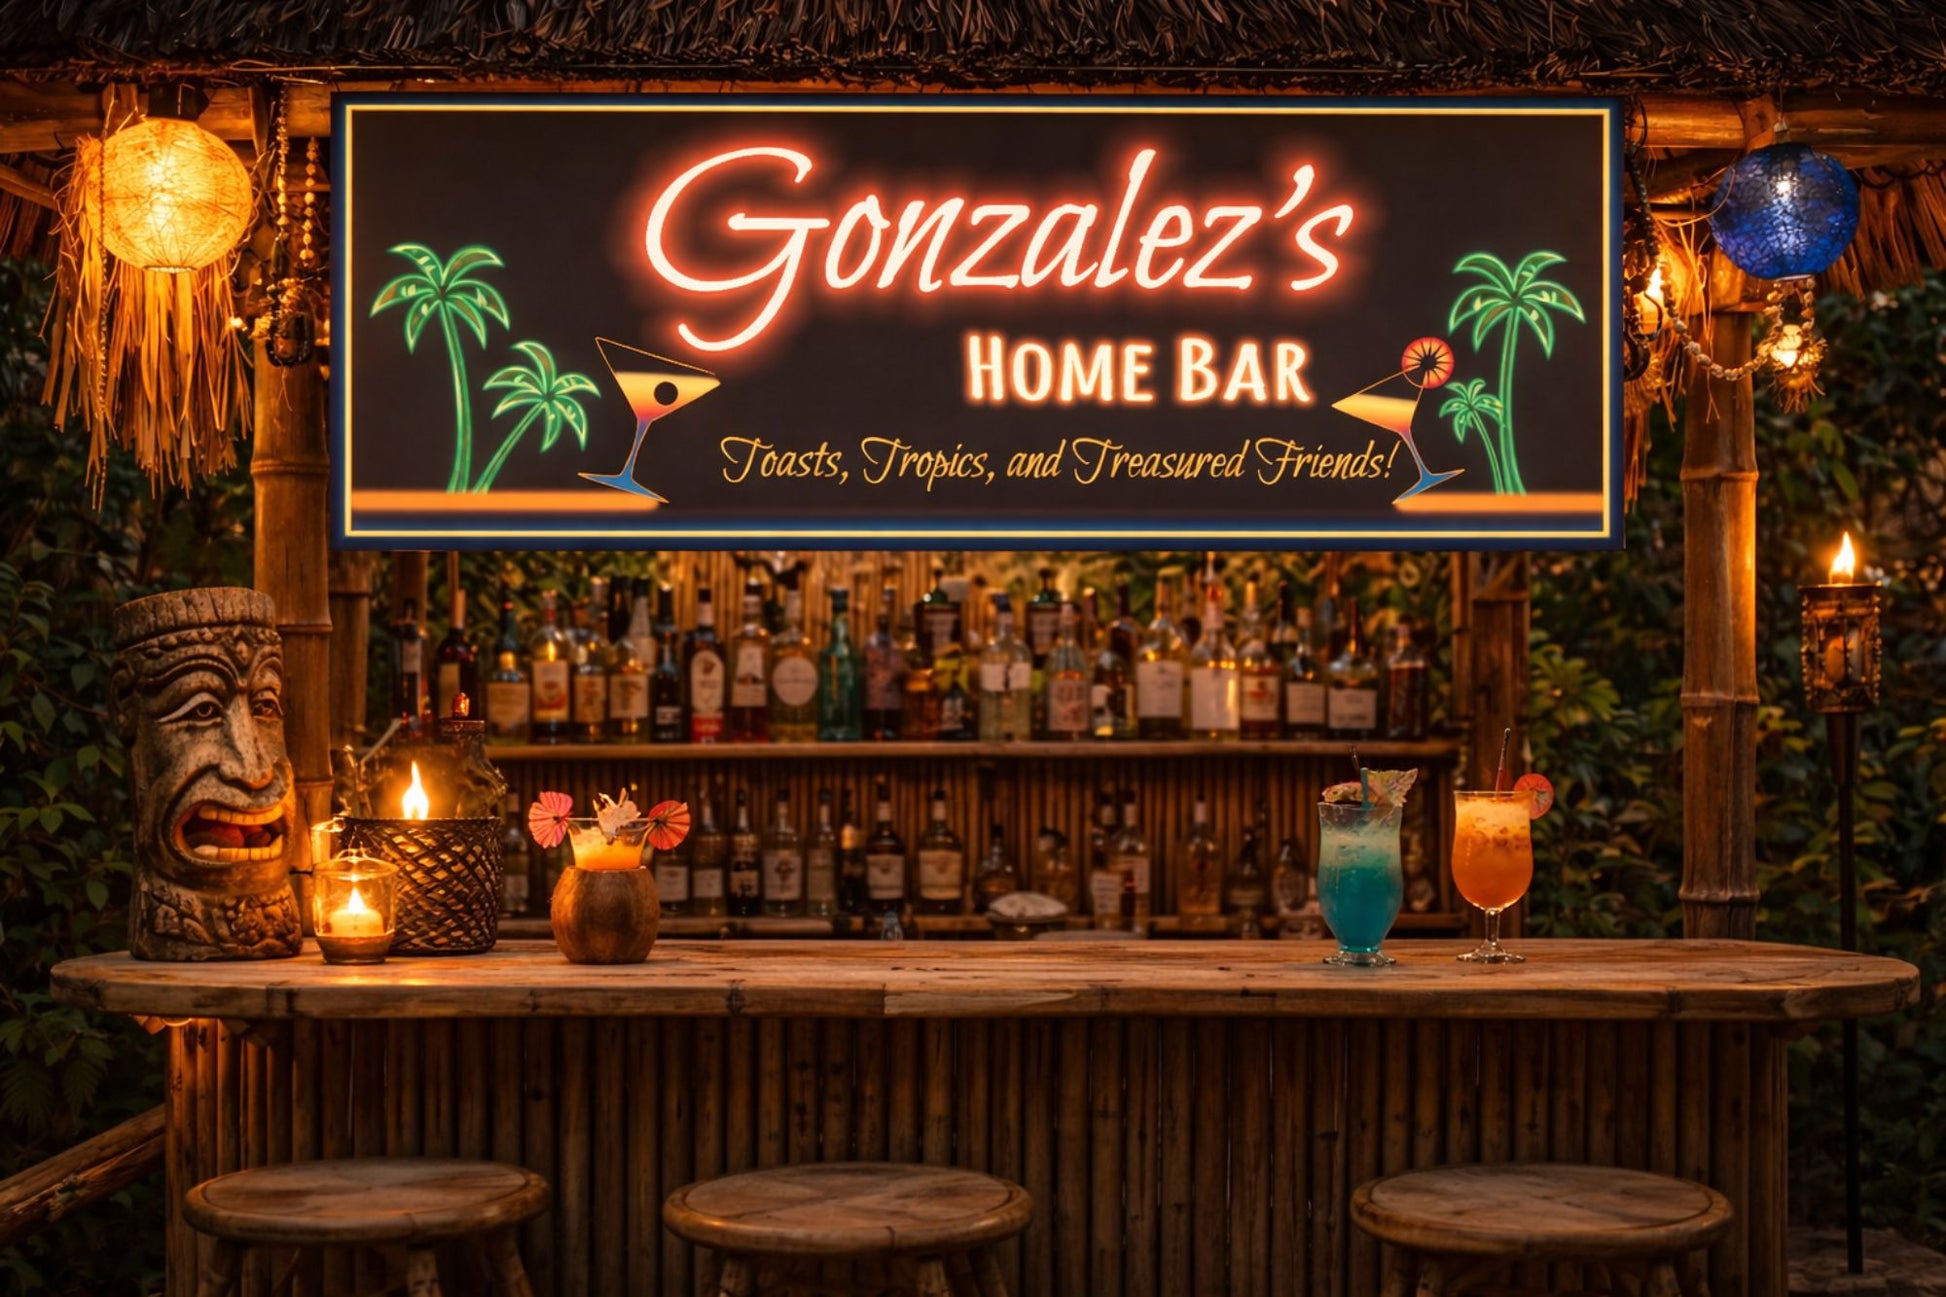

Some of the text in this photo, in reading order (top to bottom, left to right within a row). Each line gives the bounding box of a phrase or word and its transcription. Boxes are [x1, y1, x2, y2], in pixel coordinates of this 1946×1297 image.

[644, 146, 1354, 352] Gonzalez's
[966, 335, 1312, 402] HOME BAR
[720, 435, 1402, 491] Toasts, Tropics, and Treasured Friends!
